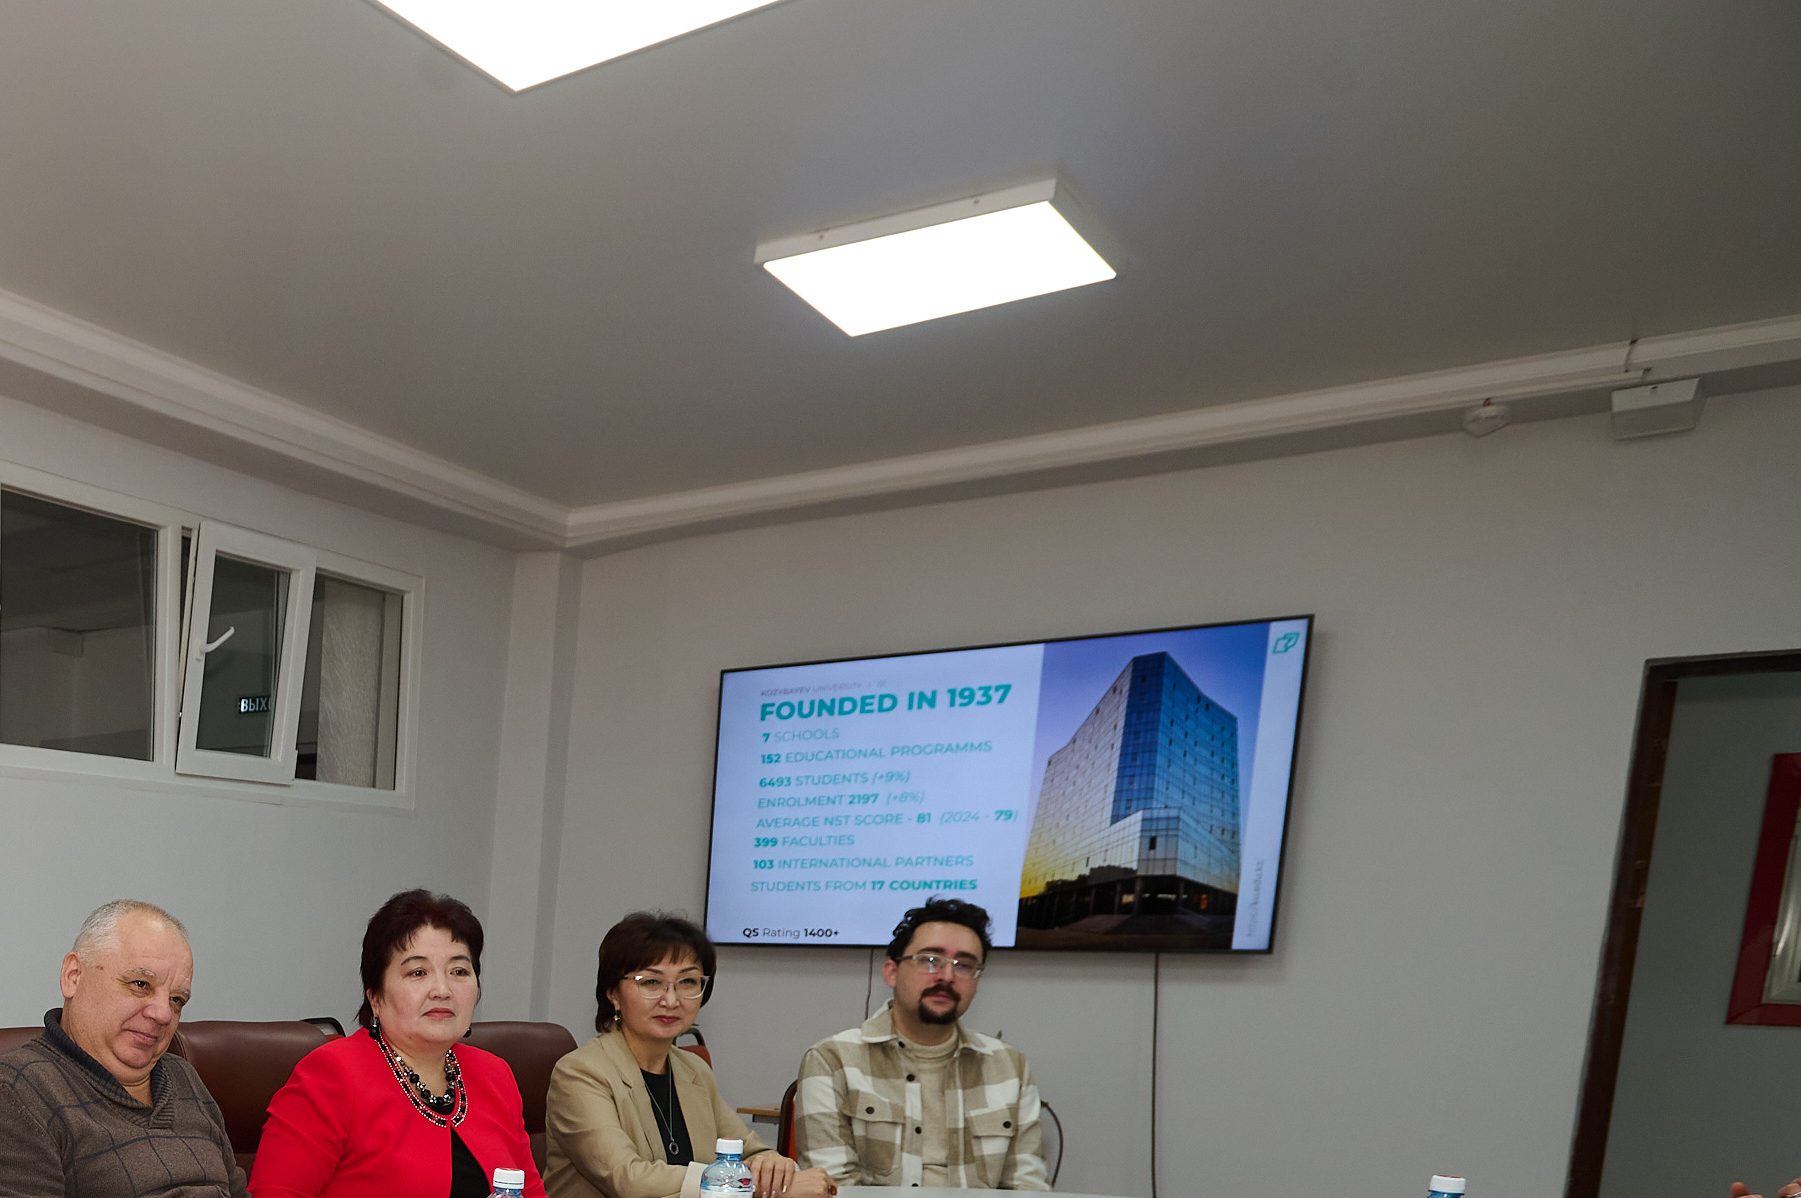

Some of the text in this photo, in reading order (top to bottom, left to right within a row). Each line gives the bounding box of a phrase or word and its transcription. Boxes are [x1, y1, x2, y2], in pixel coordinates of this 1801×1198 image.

[760, 684, 1012, 721] FOUNDED IN 1937
[762, 728, 840, 743] 7 SCHOOLS
[761, 741, 993, 764] 152 EDUCATIONAL PROGRAMMS
[759, 770, 911, 788] 6493 STUDENTS (+9%)
[757, 794, 846, 808] ENROLMENT
[848, 793, 879, 804] 2197
[755, 815, 820, 829] AVERAGE
[823, 815, 851, 827] NST
[855, 813, 903, 826] SCORE
[916, 812, 931, 824] 81
[939, 810, 980, 825] (2024
[994, 809, 1018, 823] 79)
[754, 834, 855, 848] 399 FACULTIES
[753, 855, 974, 870] 103 INTERNATIONAL PARTNERS
[751, 879, 977, 892] STUDENTS FROM 17 COUNTRIES
[742, 927, 839, 940] QS Rating 1400+
